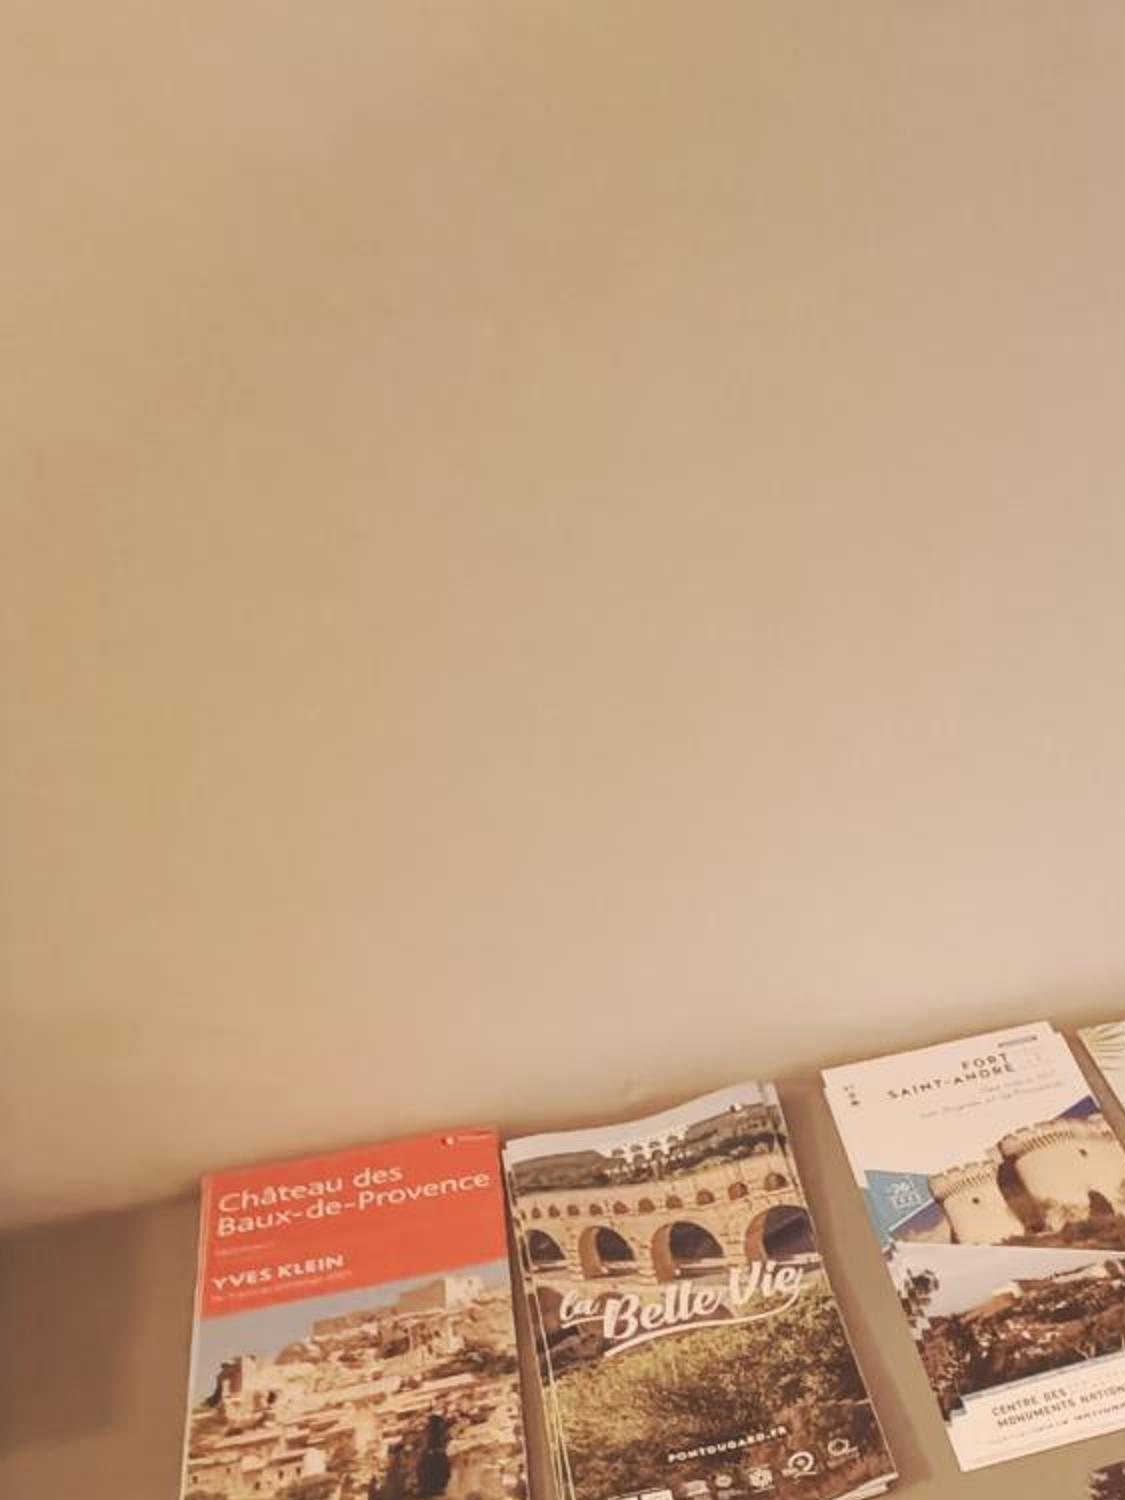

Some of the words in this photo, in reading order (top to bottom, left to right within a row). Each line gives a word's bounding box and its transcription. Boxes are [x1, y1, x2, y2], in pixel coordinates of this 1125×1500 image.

[961, 1053, 1007, 1071] FORT
[217, 1172, 491, 1237] Baux-de-Provence
[218, 1176, 343, 1213] Château
[352, 1165, 403, 1188] des
[213, 1267, 272, 1290] YVES
[277, 1255, 344, 1279] KLEIN
[603, 1280, 721, 1340] Belle
[727, 1262, 803, 1305] Vie
[992, 1396, 1036, 1417] CENTRE
[997, 1399, 1076, 1427] MONUMENTS
